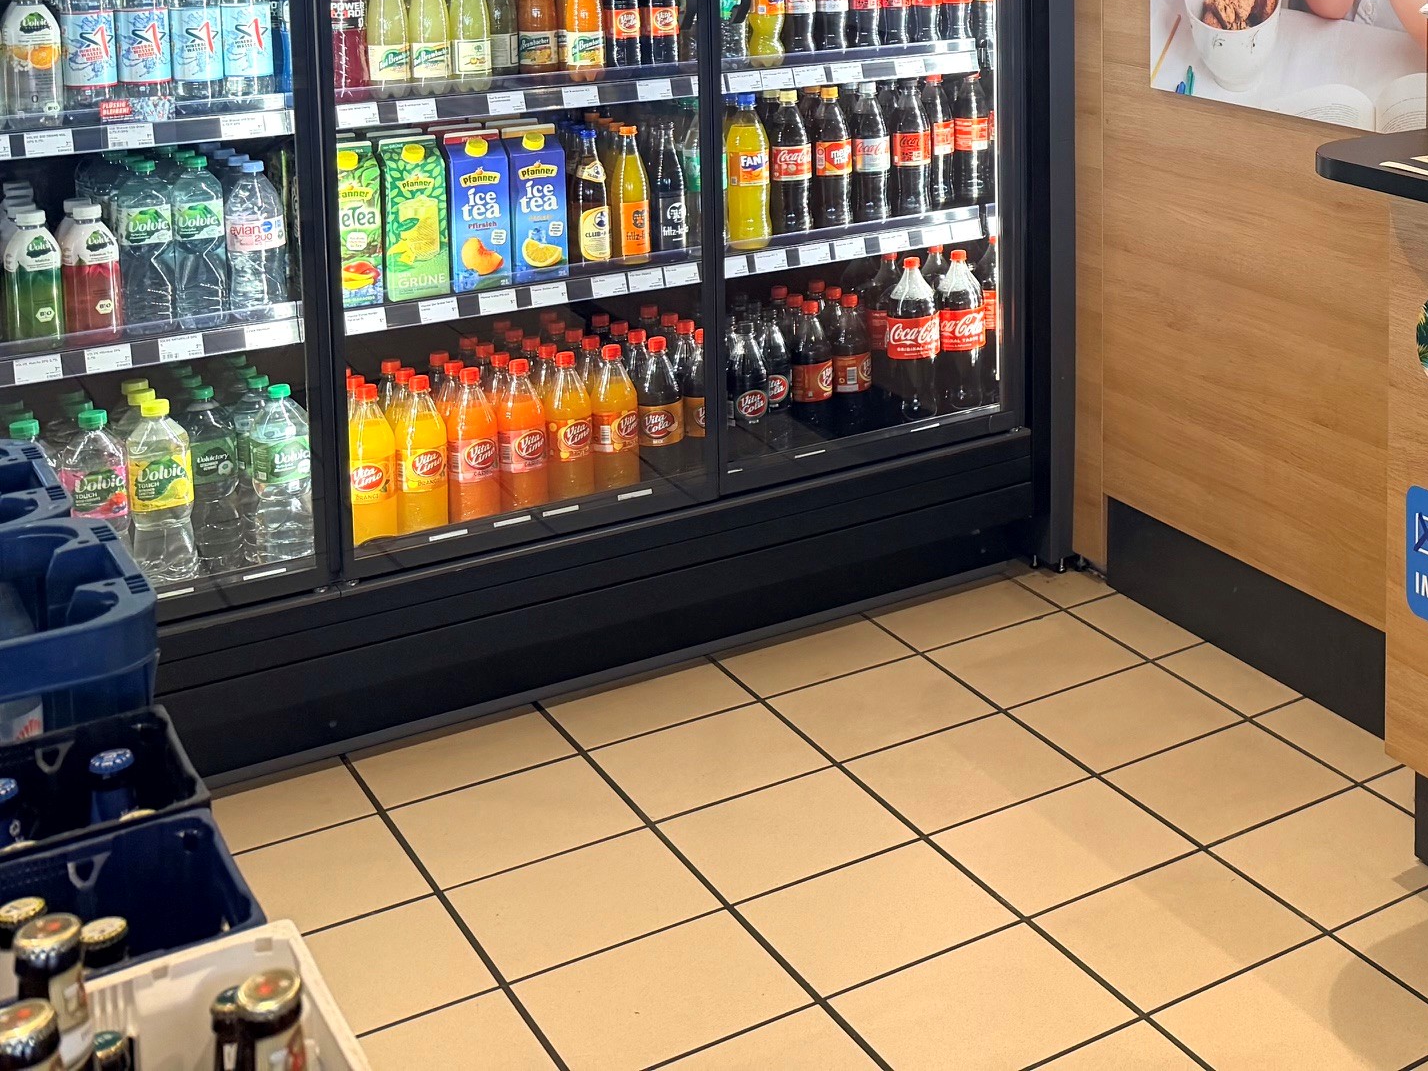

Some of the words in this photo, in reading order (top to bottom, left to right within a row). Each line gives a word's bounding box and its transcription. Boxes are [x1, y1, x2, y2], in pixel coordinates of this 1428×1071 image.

[330, 2, 365, 10] POWER
[462, 173, 499, 184] pfanner
[520, 166, 556, 178] pfanner
[520, 193, 558, 211] tea
[461, 201, 501, 219] tea
[129, 218, 170, 233] Volvic
[177, 213, 218, 228] Volvic
[398, 272, 446, 288] GRÜNE
[137, 464, 186, 483] Volvic
[74, 473, 126, 494] Volvic
